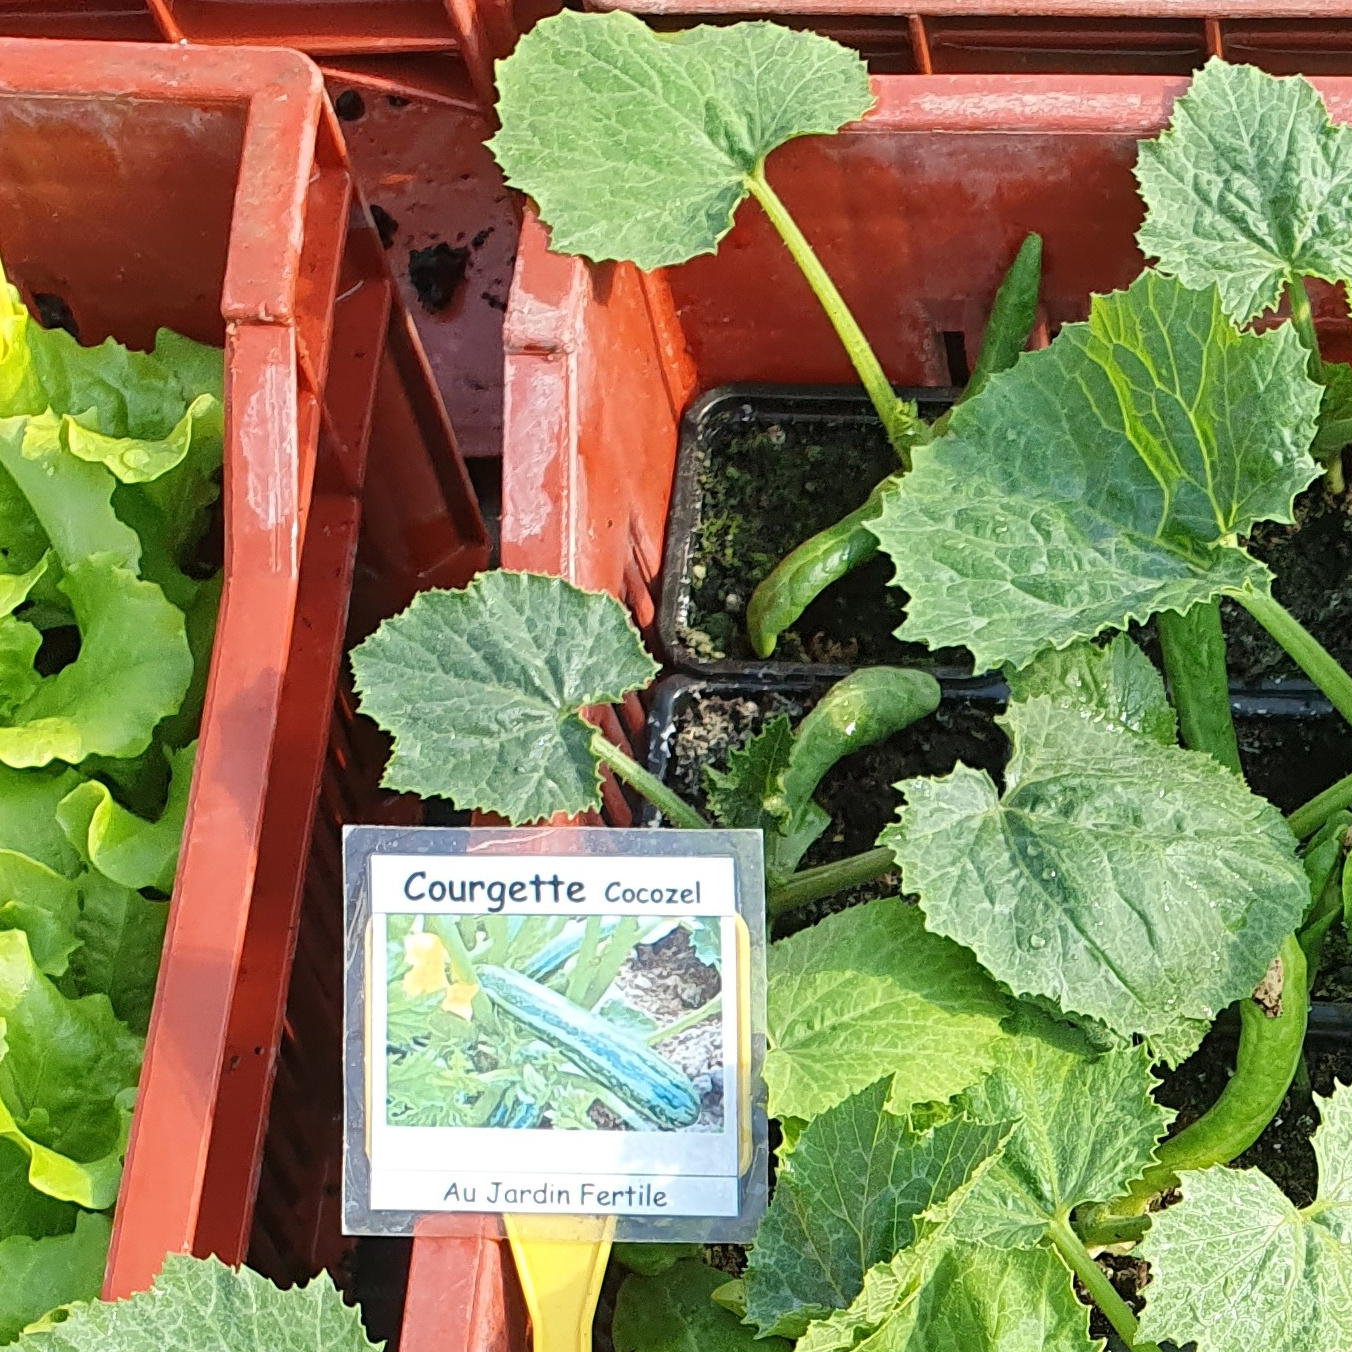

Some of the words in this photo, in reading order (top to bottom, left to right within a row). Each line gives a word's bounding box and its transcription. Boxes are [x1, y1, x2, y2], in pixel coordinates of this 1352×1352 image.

[404, 871, 586, 913] Courgette
[604, 881, 702, 904] Cocozel
[443, 1182, 477, 1203] Au
[486, 1182, 571, 1206] Jardin
[580, 1183, 668, 1207] Fertile
